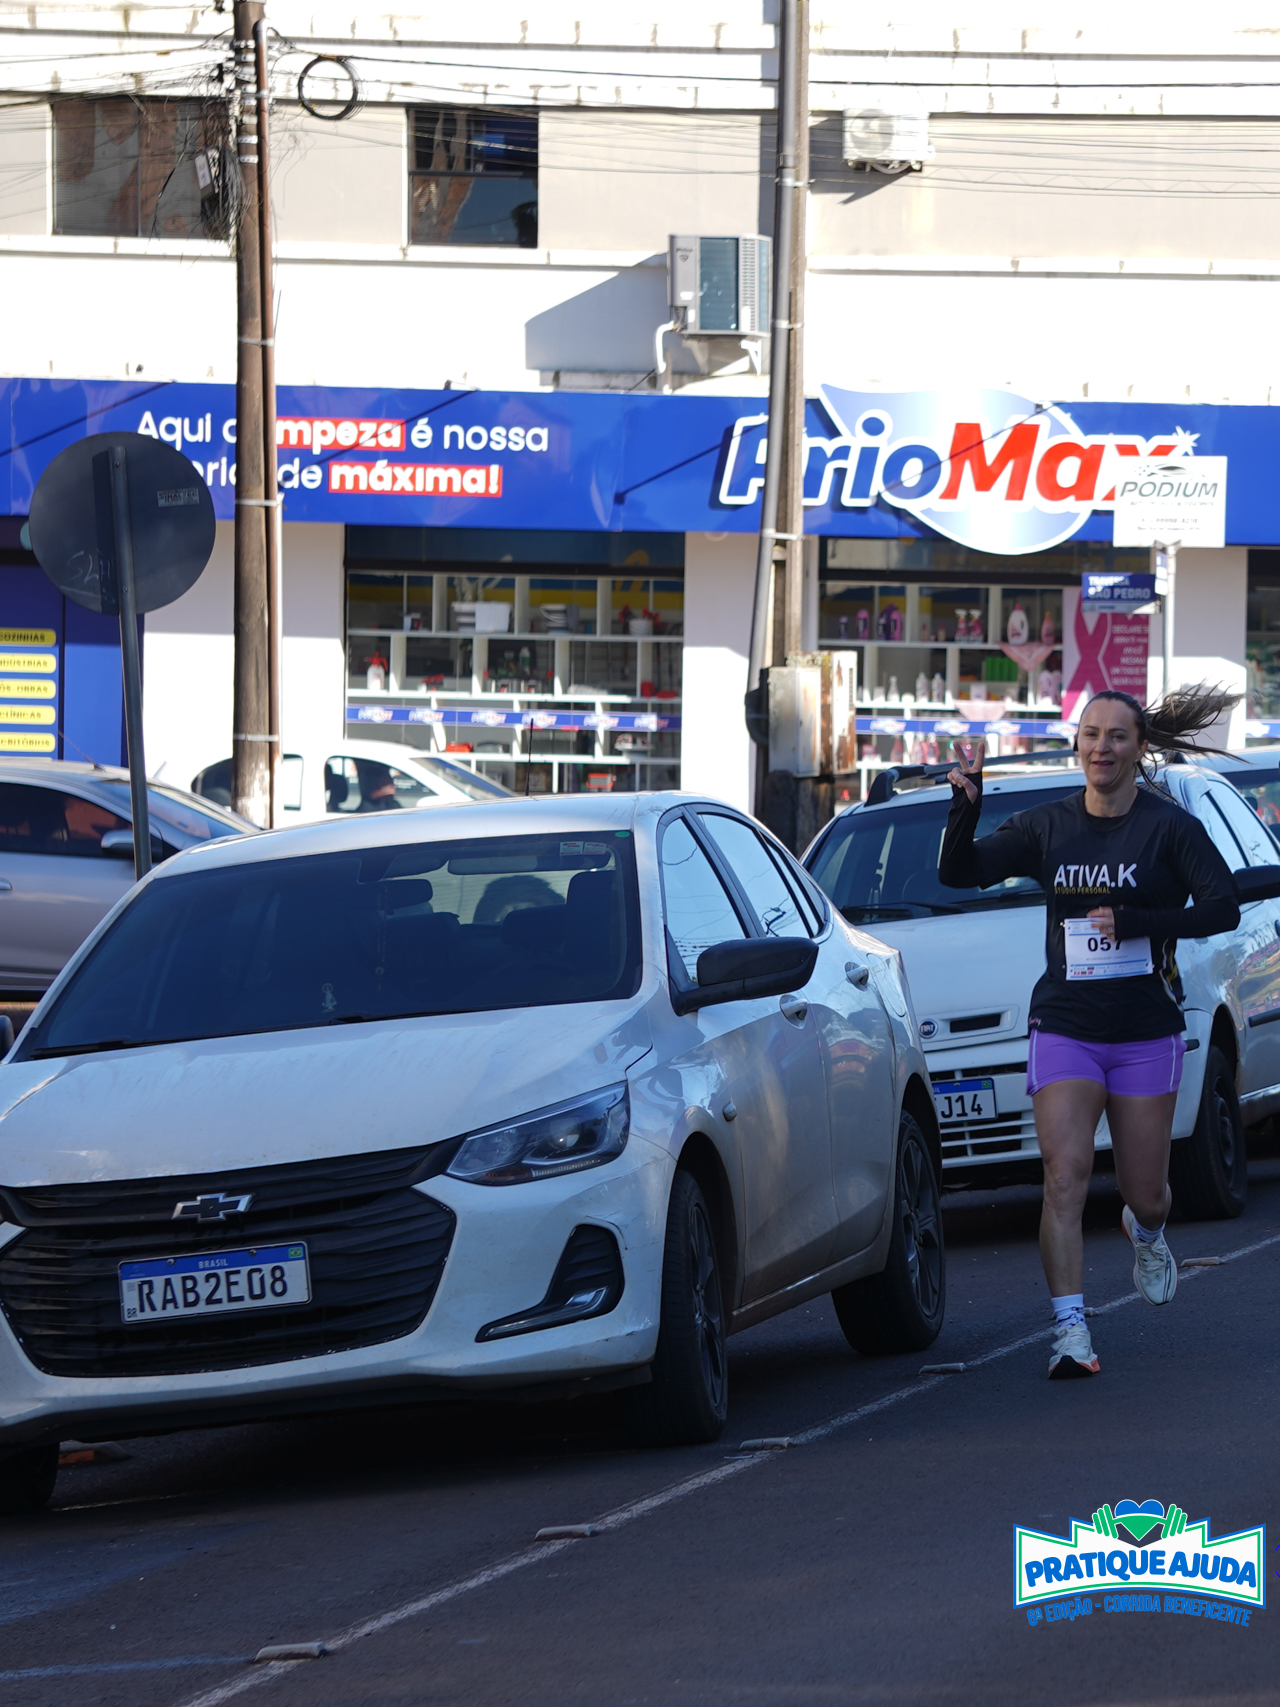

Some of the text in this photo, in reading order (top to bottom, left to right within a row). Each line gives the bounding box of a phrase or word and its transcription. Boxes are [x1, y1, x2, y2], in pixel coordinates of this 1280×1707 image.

[137, 411, 212, 451] Aqui
[275, 419, 401, 455] mpeza
[410, 417, 433, 449] é
[443, 424, 549, 451] nossa
[331, 459, 500, 494] máxima!
[1119, 481, 1219, 498] PODIUM
[1113, 587, 1151, 599] PEDRO
[1053, 863, 1137, 888] ATIVA.K
[1077, 886, 1111, 894] PERSONAL
[940, 1093, 983, 1119] J14
[198, 1258, 229, 1269] BRASIL
[137, 1265, 288, 1313] RAB2E08
[126, 1307, 138, 1319] BR
